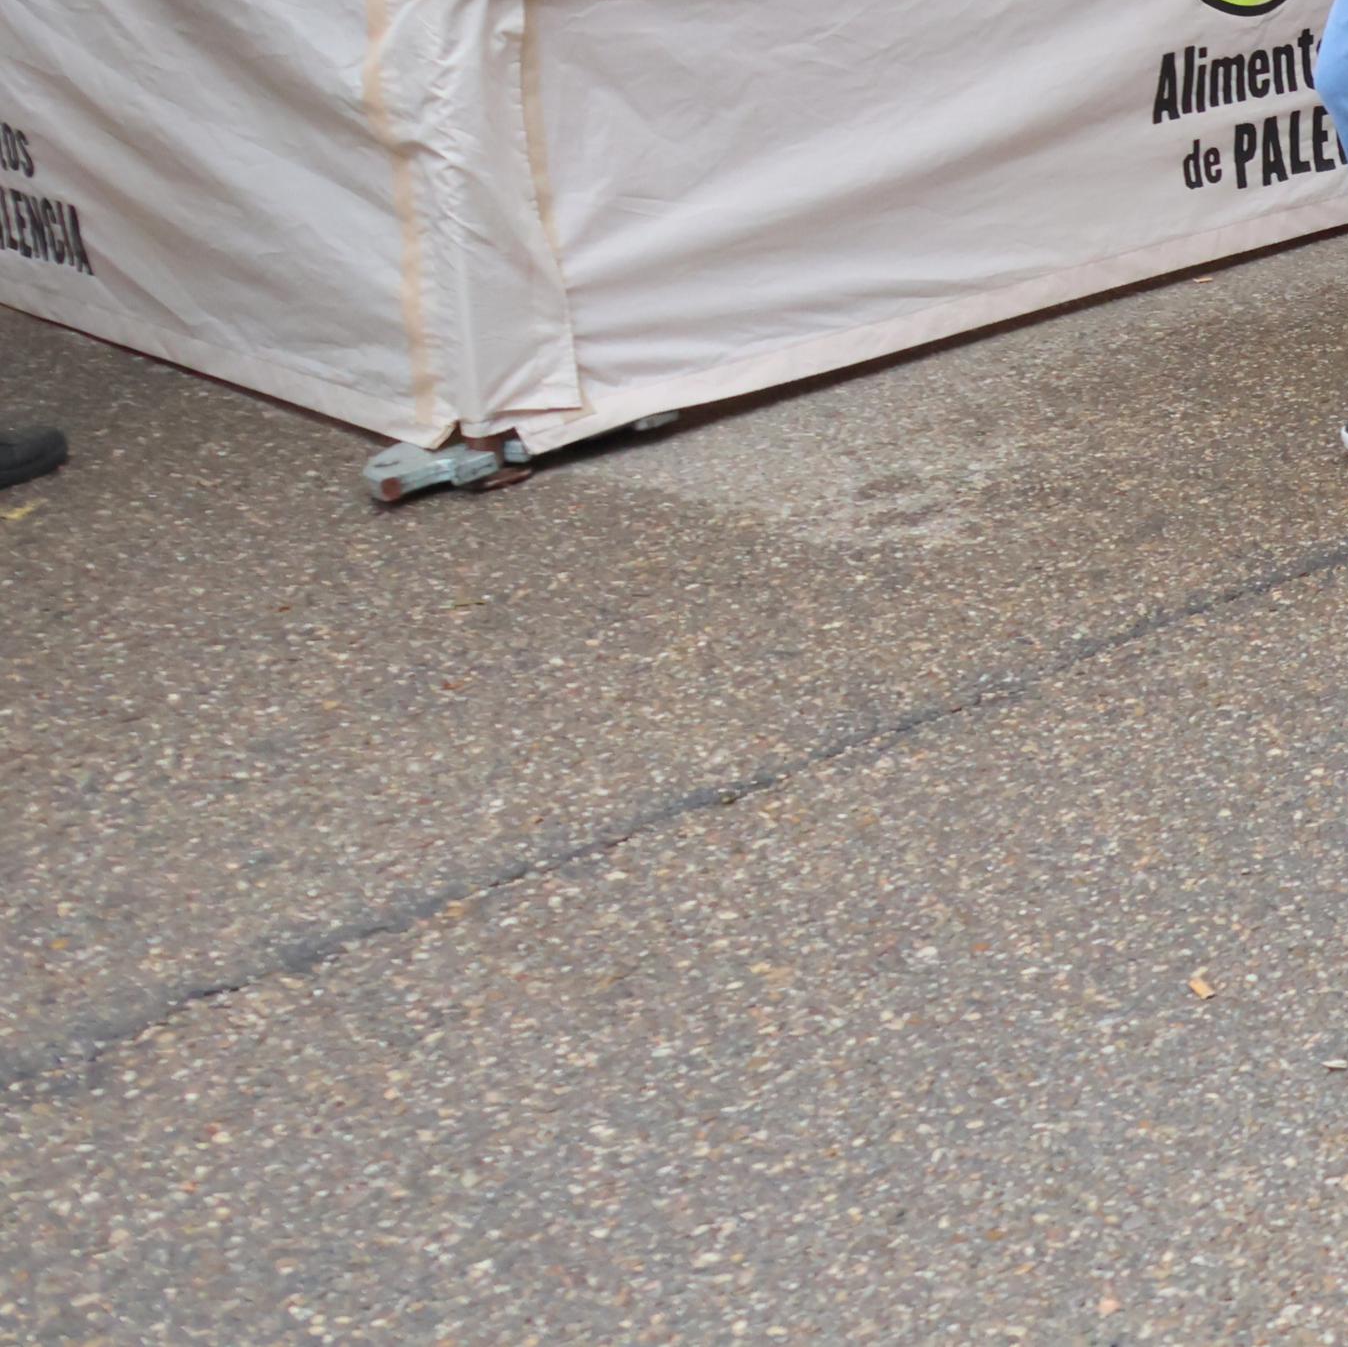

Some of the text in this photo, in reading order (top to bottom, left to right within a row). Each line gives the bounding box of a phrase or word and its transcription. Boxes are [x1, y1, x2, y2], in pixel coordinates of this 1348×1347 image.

[1152, 27, 1322, 125] Aliment
[1183, 139, 1223, 190] de
[0, 185, 95, 276] LENCIA
